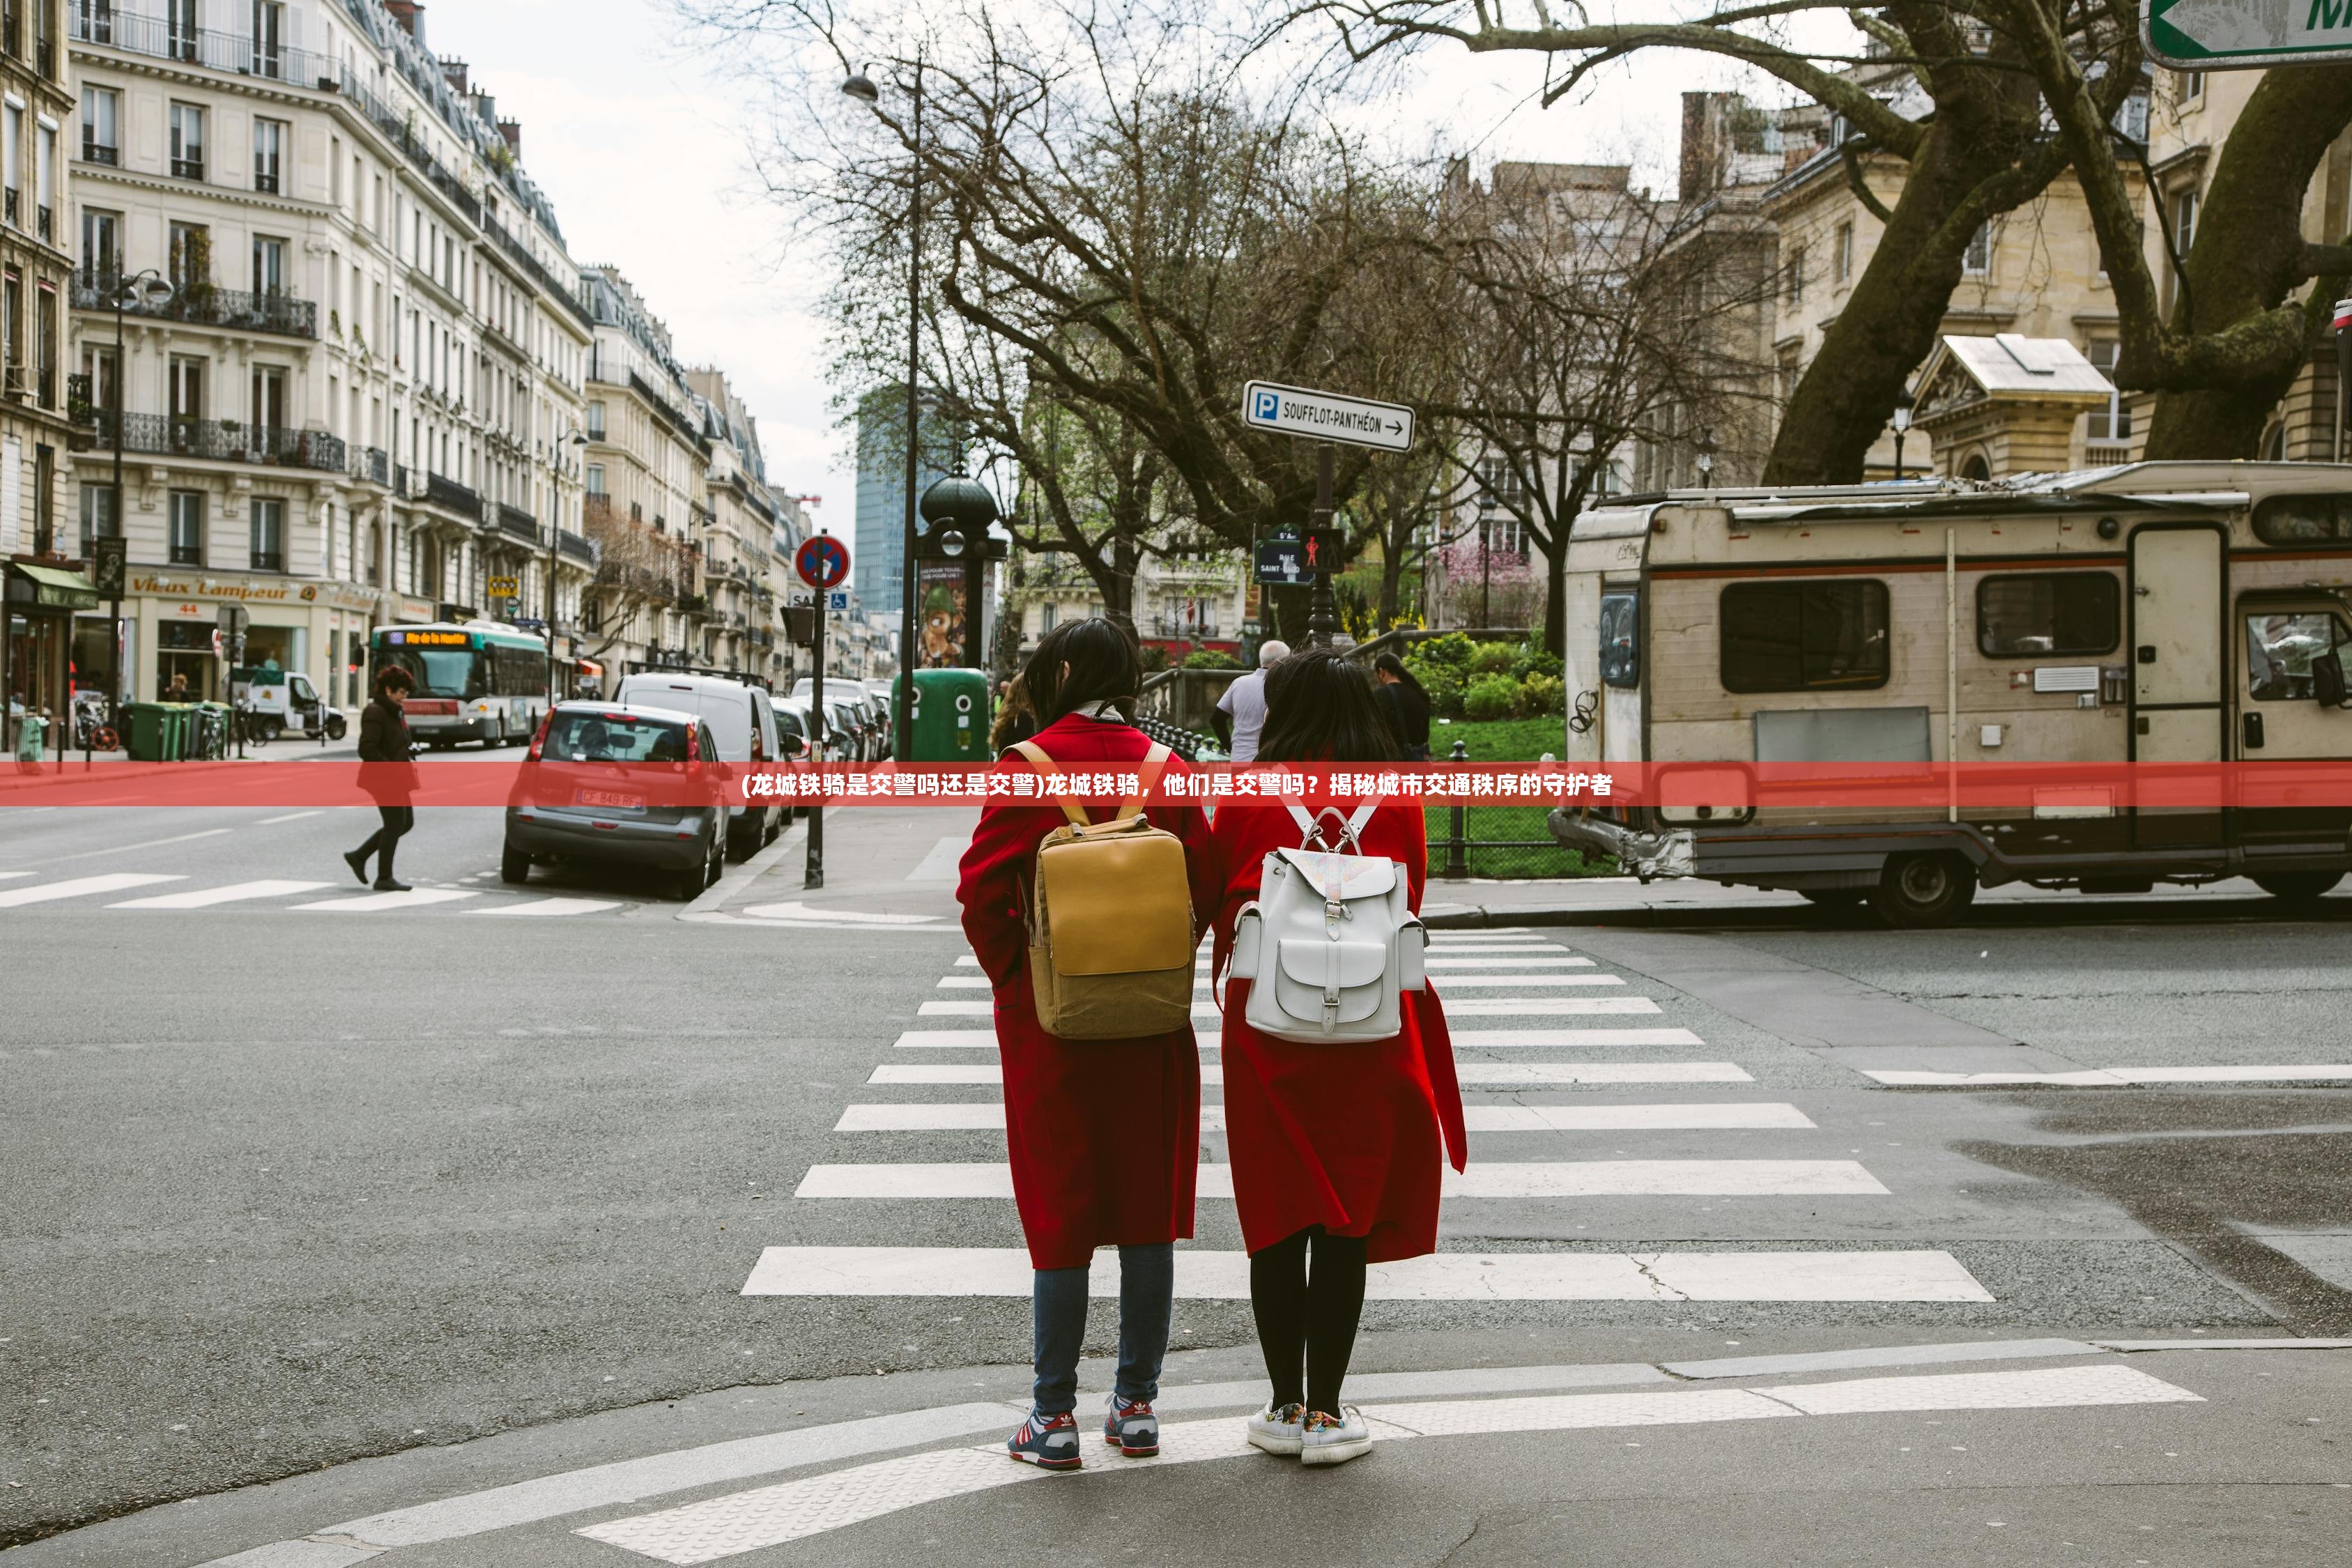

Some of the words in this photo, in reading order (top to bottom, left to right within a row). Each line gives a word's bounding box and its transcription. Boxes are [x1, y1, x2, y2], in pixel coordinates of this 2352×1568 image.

[1284, 401, 1382, 433] SOUFFLOT-PANTHÉON
[133, 579, 190, 594] Vieux
[179, 604, 197, 613] 44
